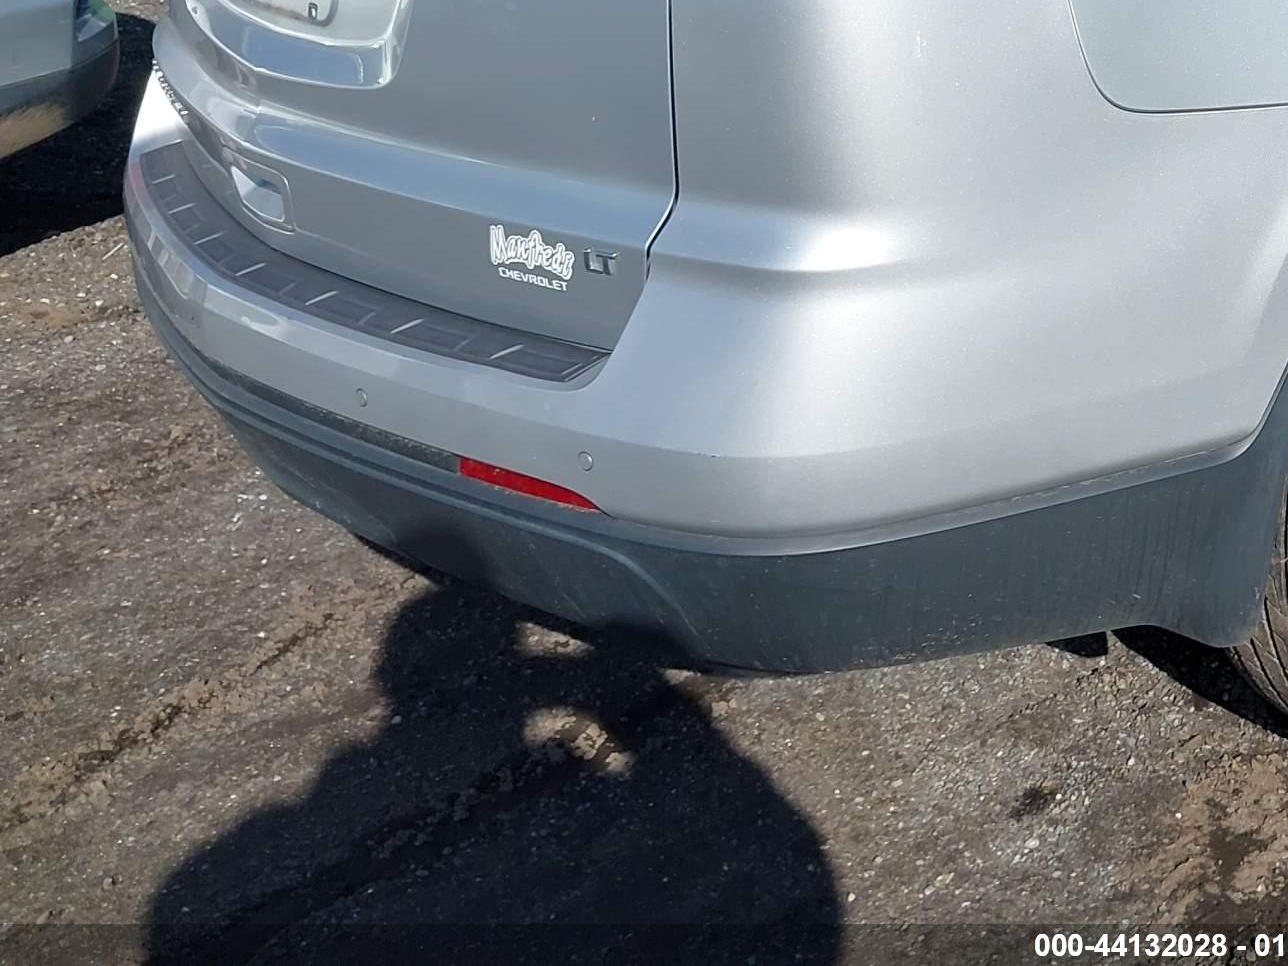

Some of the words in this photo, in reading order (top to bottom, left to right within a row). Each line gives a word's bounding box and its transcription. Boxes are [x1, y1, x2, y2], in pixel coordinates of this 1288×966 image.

[489, 225, 575, 280] Manfredi
[583, 247, 621, 276] LT
[498, 266, 568, 292] CHEVROLET
